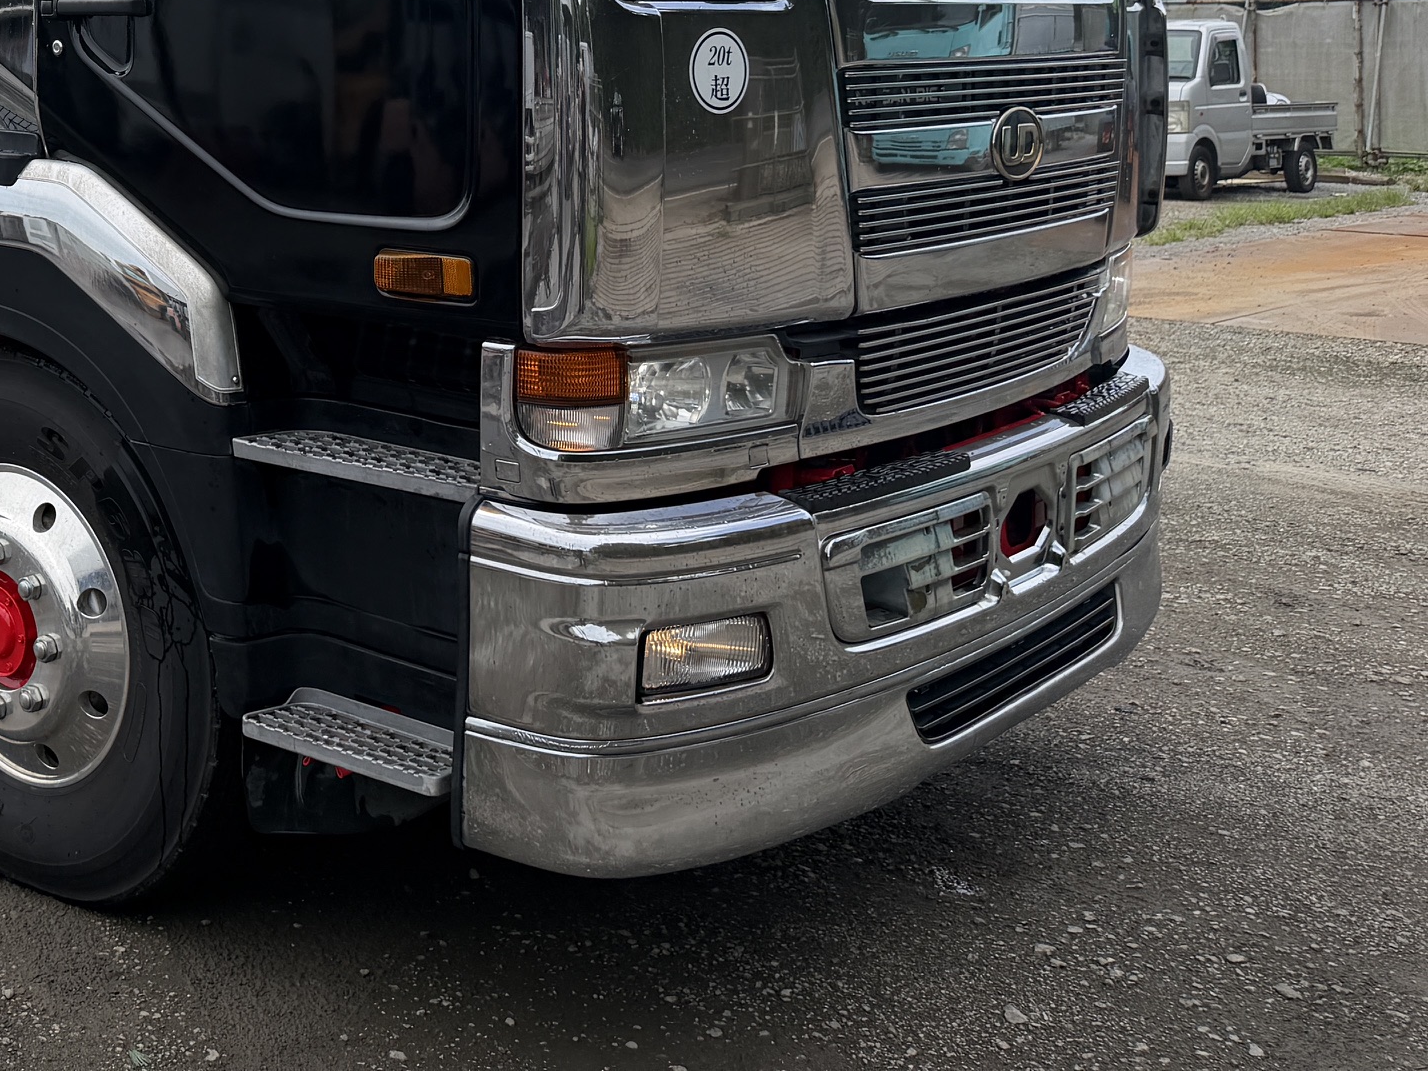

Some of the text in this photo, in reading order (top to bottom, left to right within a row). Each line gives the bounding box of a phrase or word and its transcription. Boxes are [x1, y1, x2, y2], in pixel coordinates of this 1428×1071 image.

[707, 45, 733, 66] 20t
[710, 74, 730, 101] 超
[1001, 122, 1040, 166] UD
